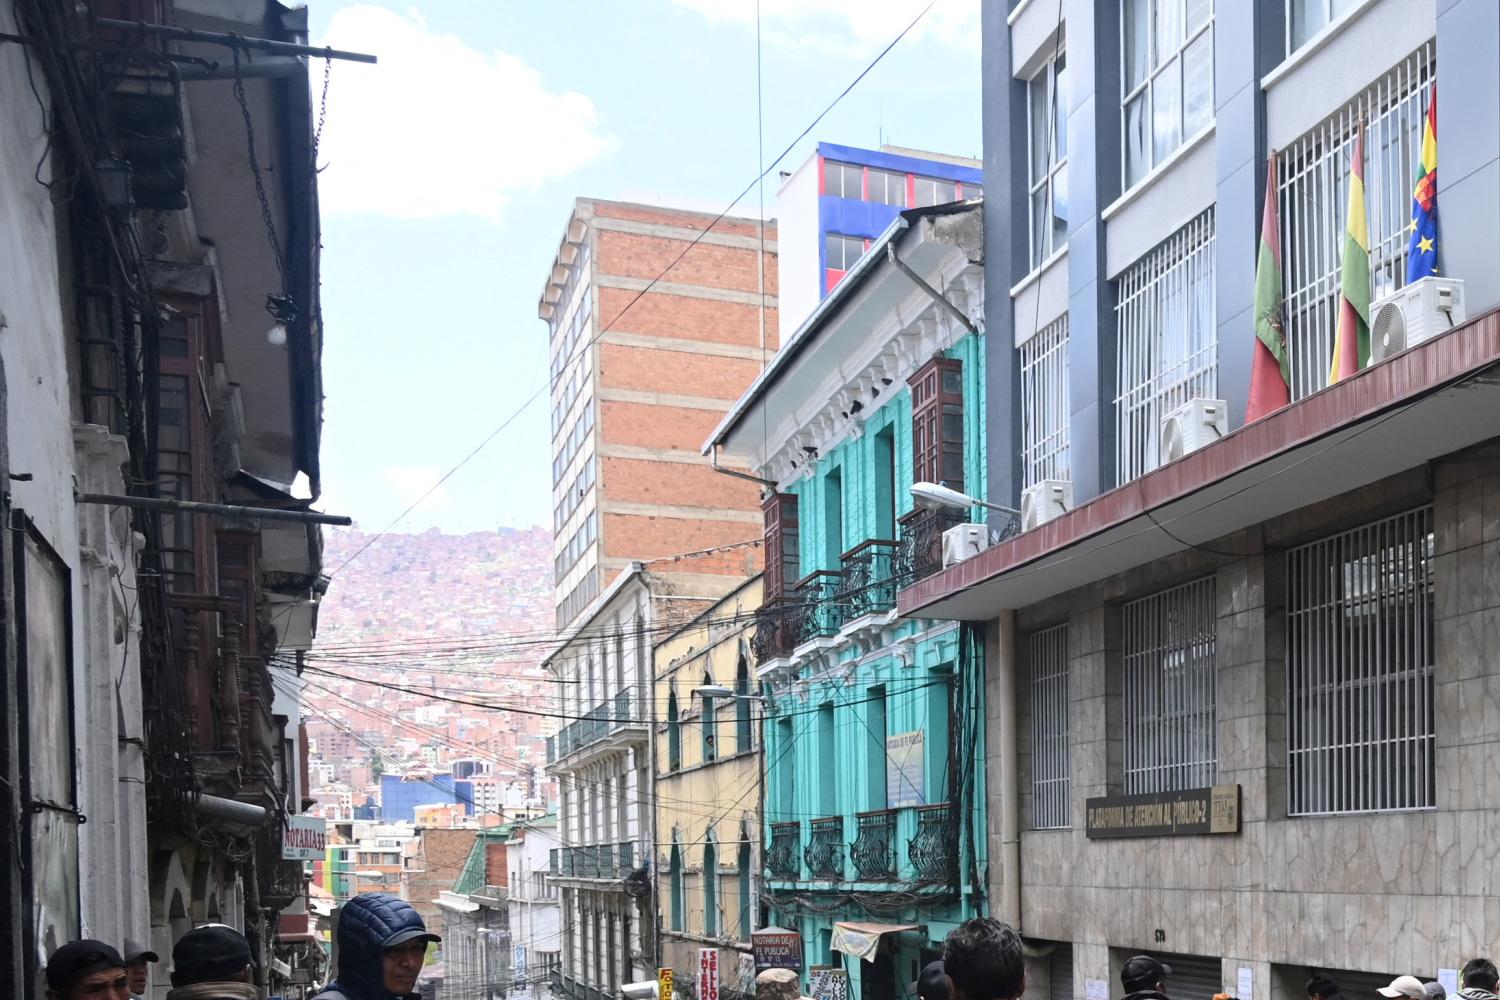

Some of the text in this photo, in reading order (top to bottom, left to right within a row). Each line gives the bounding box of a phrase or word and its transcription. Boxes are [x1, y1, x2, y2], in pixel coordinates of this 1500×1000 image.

[1088, 806, 1125, 829] PLATAFORMA
[1125, 806, 1134, 827] DE
[1134, 797, 1163, 827] ATENCIÓN
[1163, 802, 1172, 825] AL
[753, 936, 790, 945] NOTARIA DE
